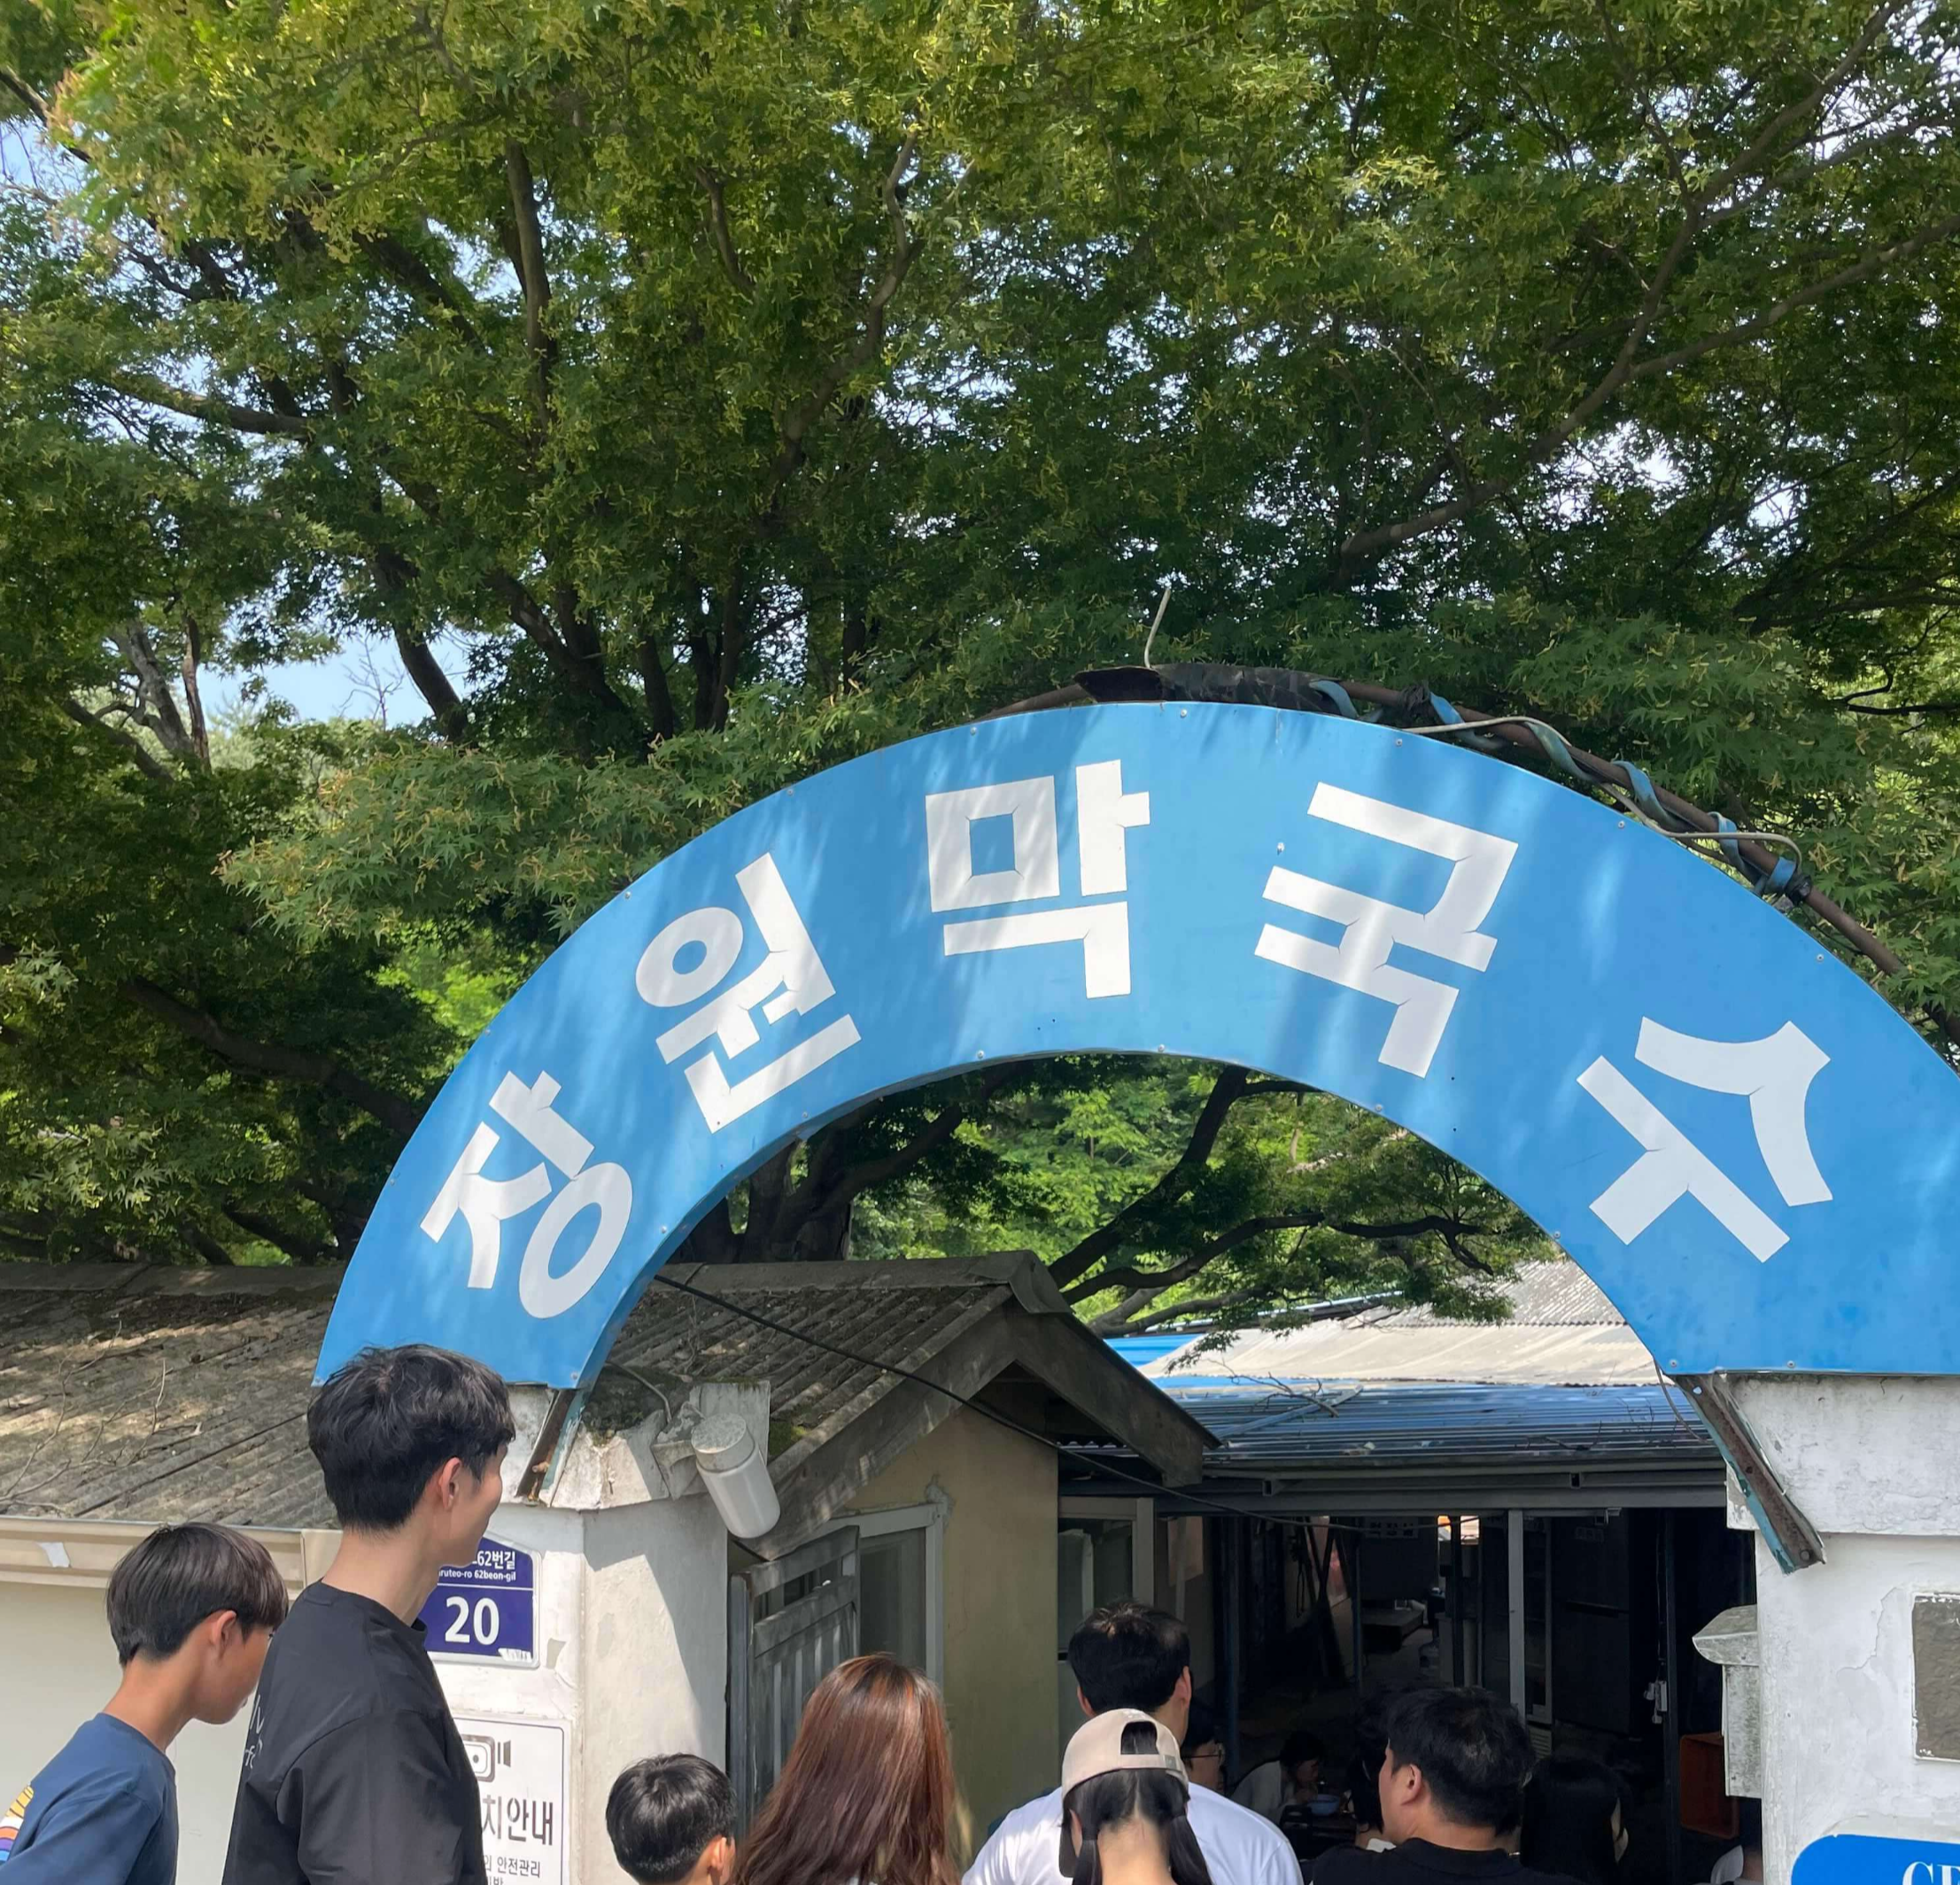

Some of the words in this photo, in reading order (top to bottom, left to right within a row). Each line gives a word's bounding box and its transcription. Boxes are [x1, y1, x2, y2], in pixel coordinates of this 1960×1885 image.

[421, 759, 1832, 1318] 장원막국수
[472, 1550, 515, 1570] 62번길
[474, 1570, 516, 1582] 62beon-gil
[445, 1595, 500, 1645] 20
[497, 1856, 541, 1879] 안전관리
